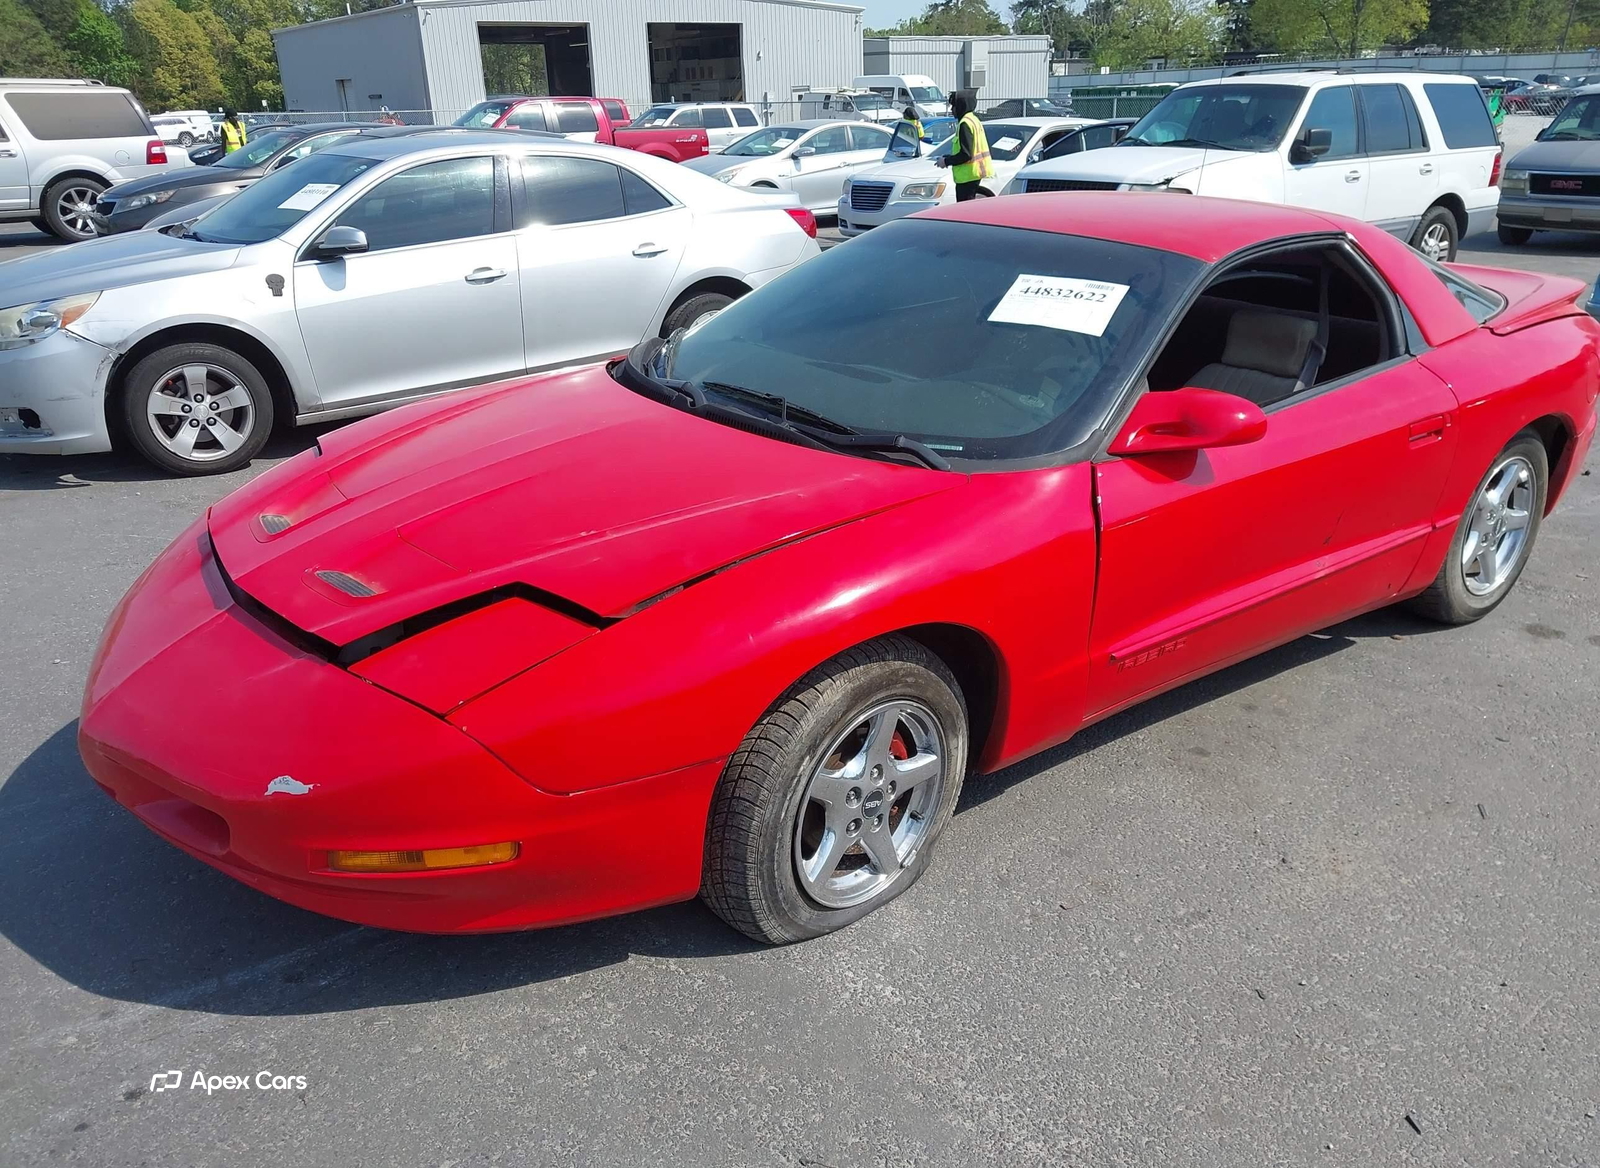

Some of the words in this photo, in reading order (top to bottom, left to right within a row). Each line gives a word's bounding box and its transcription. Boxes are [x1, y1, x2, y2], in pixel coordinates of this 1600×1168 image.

[1550, 180, 1583, 189] GMC
[1019, 285, 1107, 303] 44832622
[865, 799, 883, 809] ABS
